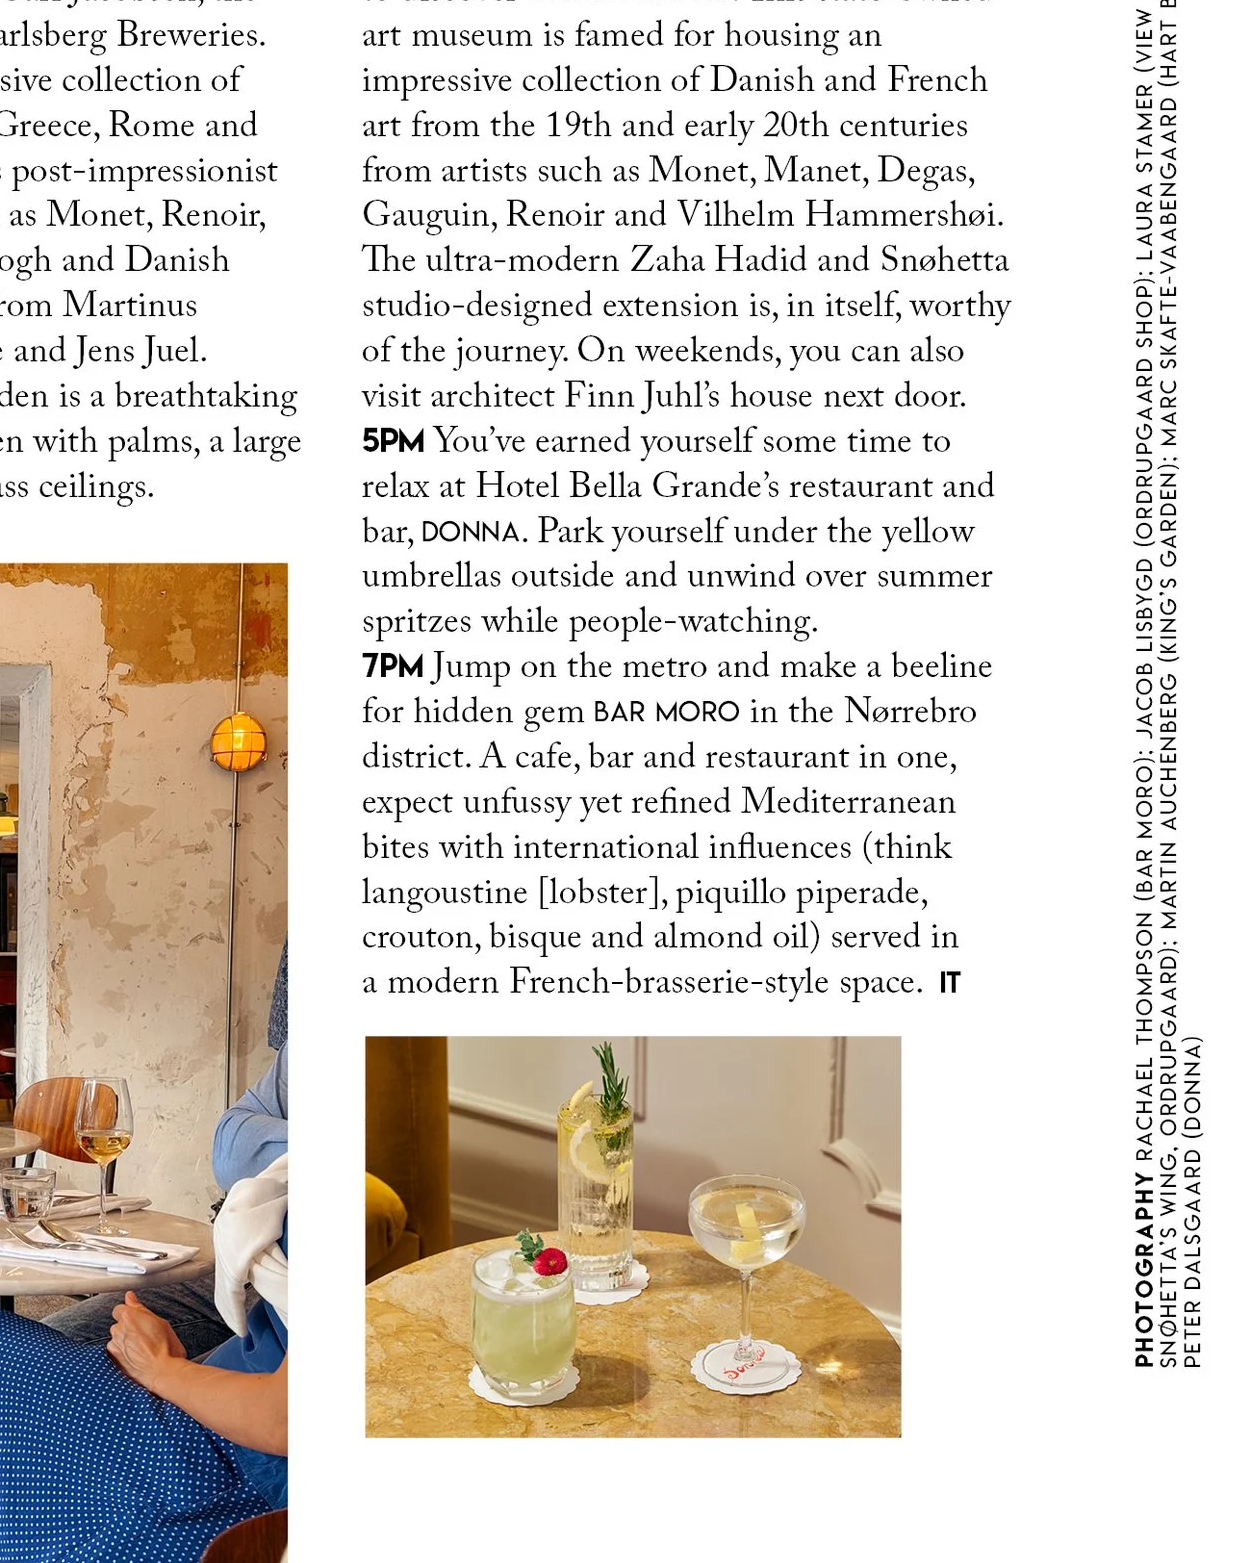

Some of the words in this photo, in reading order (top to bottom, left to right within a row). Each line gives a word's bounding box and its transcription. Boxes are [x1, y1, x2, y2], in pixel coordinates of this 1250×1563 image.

[1133, 9, 1155, 72] (VIEW
[1157, 20, 1179, 86] (HART
[1136, 85, 1152, 172] STAMER
[63, 245, 114, 271] and
[125, 245, 229, 271] Danish
[1136, 184, 1152, 259] LAURA
[1160, 98, 1176, 369] SKAFTE-VAABENGAARD
[1133, 272, 1155, 347] SHOP);
[1133, 359, 1155, 546] (ORDRUPGAARD
[1160, 381, 1176, 445] MARC
[1157, 457, 1179, 567] GARDEN);
[1136, 559, 1152, 651] LISBYGD
[1157, 579, 1179, 662] (KING’S
[363, 696, 404, 722] for
[414, 696, 513, 722] hidden
[524, 707, 584, 732] gem
[595, 701, 644, 721] BAR
[657, 701, 739, 722] MORO
[751, 699, 778, 722] in
[789, 696, 833, 722] the
[845, 696, 976, 722] Nørrebro
[1136, 663, 1152, 739] JACOB
[1133, 751, 1155, 838] MORO);
[1160, 674, 1176, 830] AUCHENBERG
[1133, 850, 1155, 900] (BAR
[1160, 843, 1176, 928] MARTIN
[363, 977, 377, 993] a
[389, 967, 499, 993] modern
[510, 966, 828, 1002] French-brasserie-style
[841, 977, 922, 1002] space.
[941, 971, 961, 993] IT
[1136, 913, 1152, 1045] THOMPSON
[1157, 941, 1179, 1135] ORDRUPGAARD);
[1136, 1058, 1152, 1160] RACHAEL
[1181, 1037, 1203, 1138] (DONNA)
[1160, 1147, 1178, 1216] WING,
[1184, 1150, 1200, 1289] DALSGAARD
[1135, 1172, 1153, 1367] PHOTOGRAPHY
[1158, 1228, 1178, 1367] SNØHETTA’S
[1184, 1301, 1200, 1367] PETER
